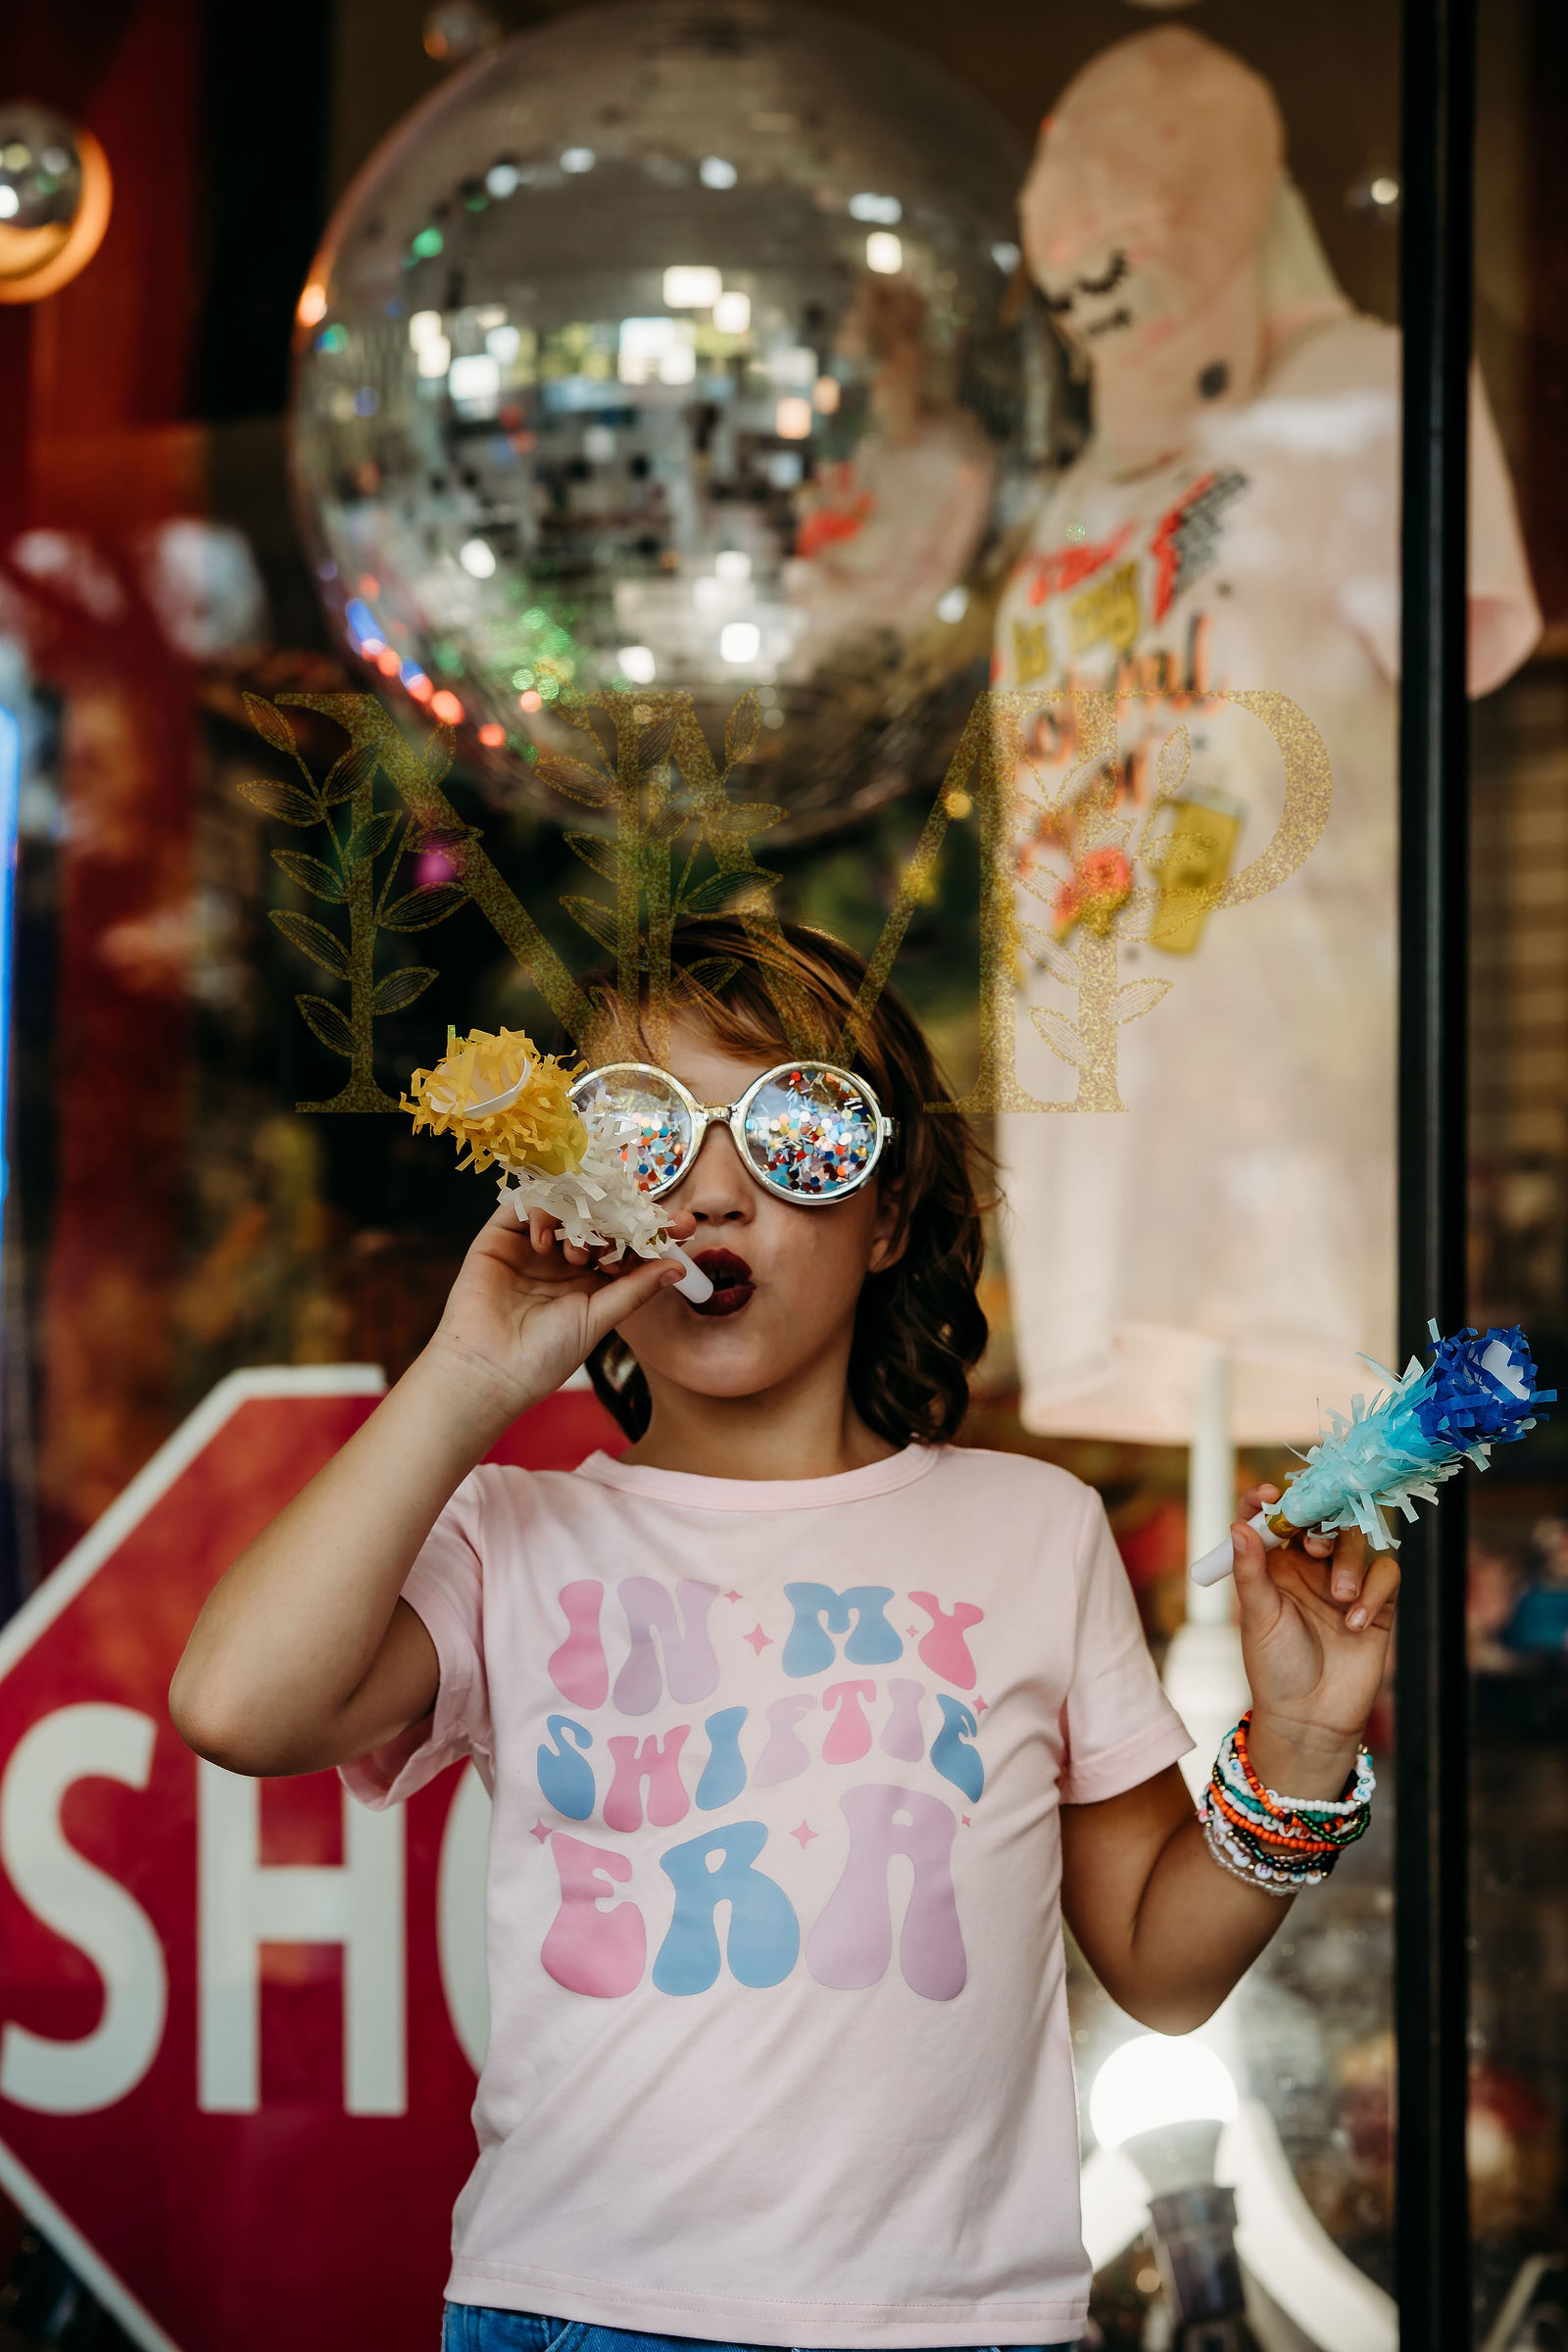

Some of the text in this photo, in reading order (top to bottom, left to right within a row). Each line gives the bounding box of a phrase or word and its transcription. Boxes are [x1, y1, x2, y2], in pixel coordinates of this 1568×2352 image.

[547, 1576, 985, 1716] IN MY
[536, 1678, 985, 1834] SWIFTIE
[540, 1784, 968, 2002] ERA
